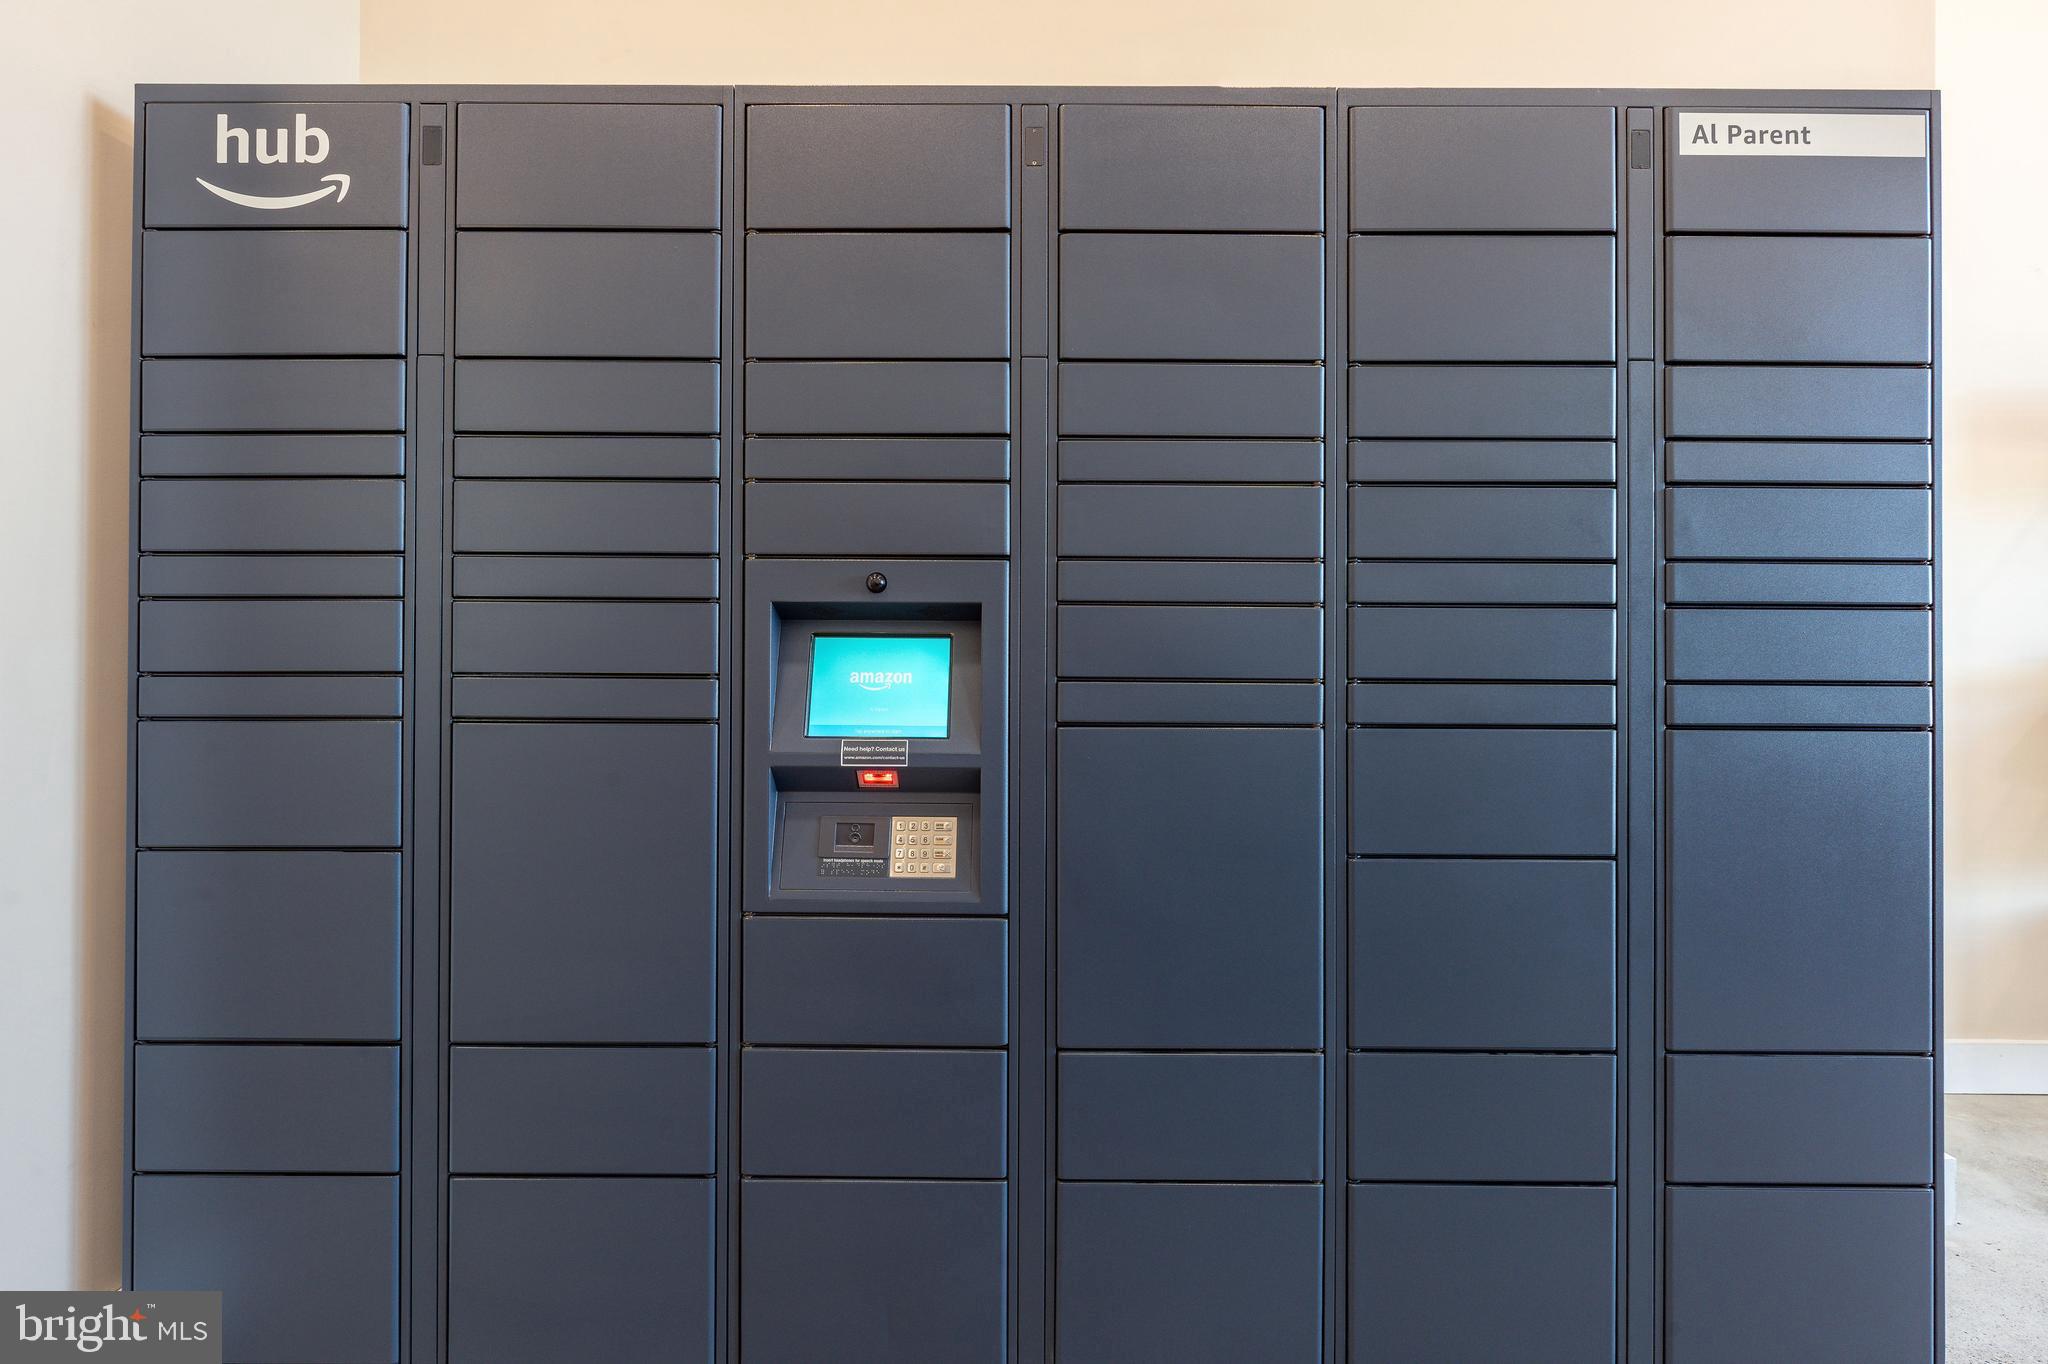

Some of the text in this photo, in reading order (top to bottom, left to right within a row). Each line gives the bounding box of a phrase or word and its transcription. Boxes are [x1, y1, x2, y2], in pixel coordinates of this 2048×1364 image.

[216, 113, 330, 164] hub
[1691, 123, 1811, 145] Al Parent
[849, 671, 913, 684] amazon
